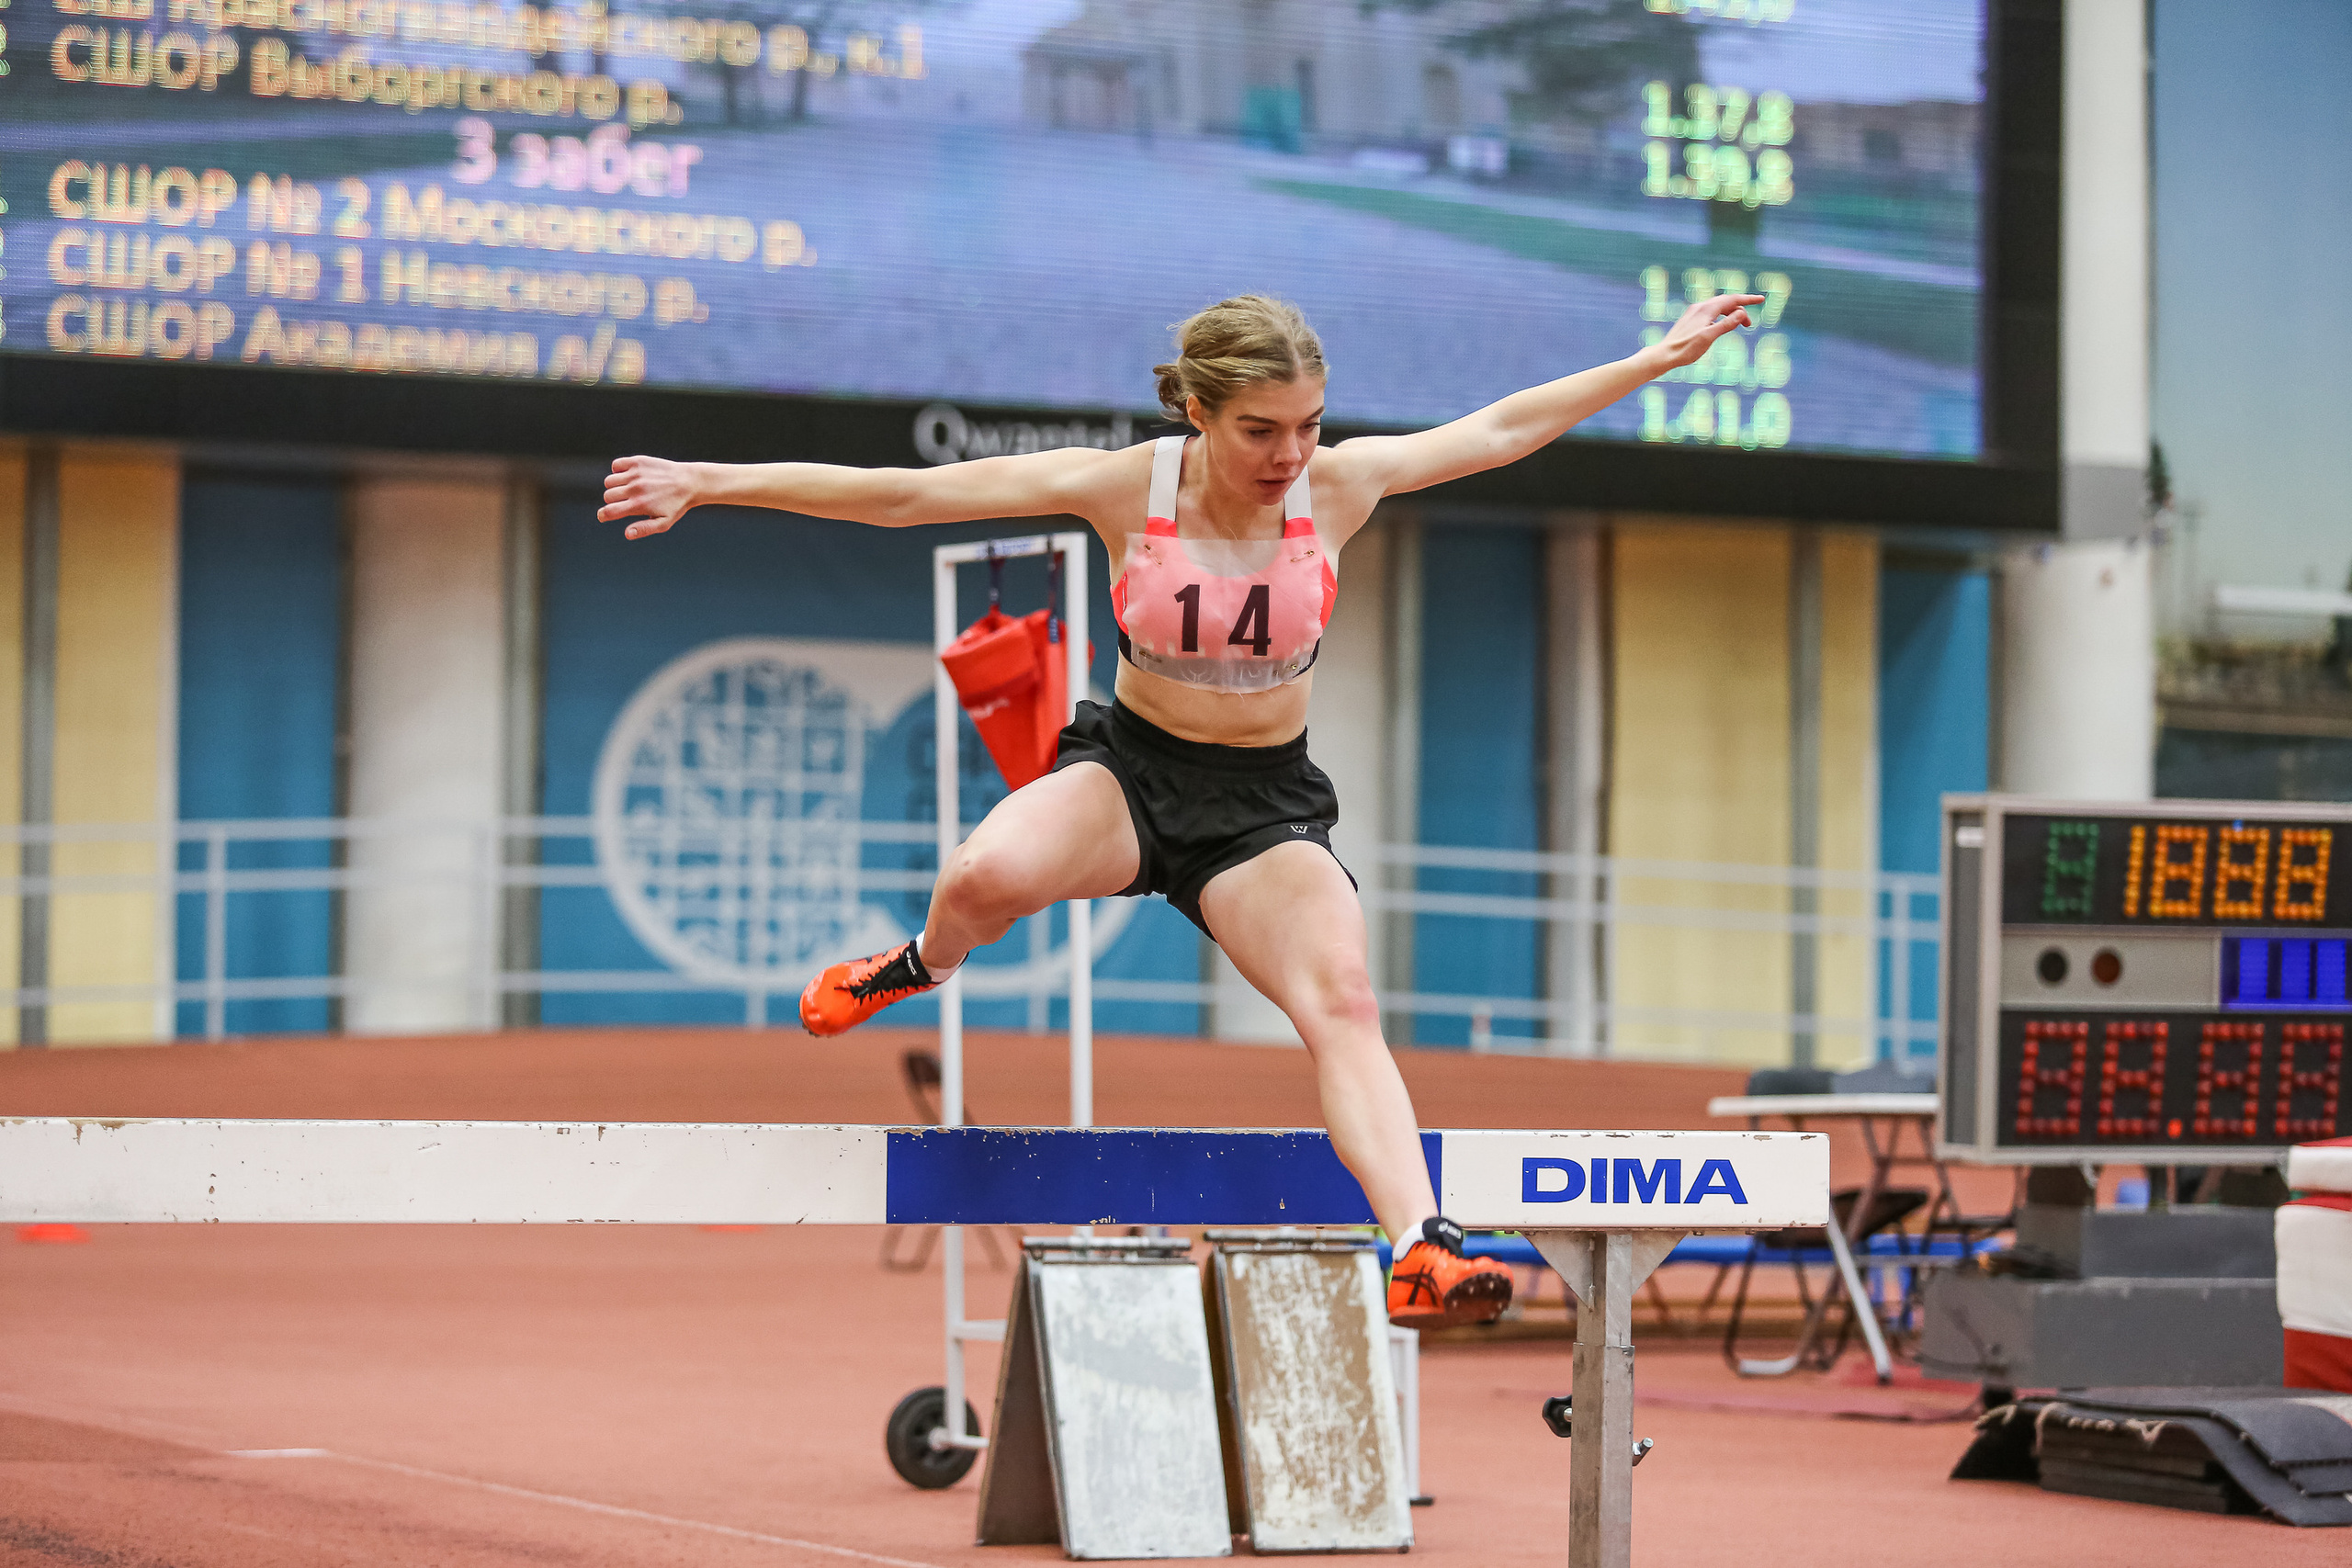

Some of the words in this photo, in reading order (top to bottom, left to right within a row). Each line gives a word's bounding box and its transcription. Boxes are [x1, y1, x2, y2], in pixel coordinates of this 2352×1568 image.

[51, 24, 240, 92] СШОР
[249, 37, 620, 121] Выборгского
[627, 79, 684, 130] р.
[454, 117, 497, 186] 3
[511, 122, 703, 198] забег
[49, 160, 238, 228] СШОР
[246, 172, 322, 236] №
[333, 177, 371, 239] 2
[381, 182, 758, 263] Московского
[762, 220, 819, 273] р.
[47, 227, 236, 293] СШОР
[246, 240, 321, 300] №
[333, 244, 370, 304] 1
[379, 248, 649, 320] Невского
[654, 277, 710, 329] р.
[47, 293, 235, 361] СШОР
[241, 305, 539, 378] Академия
[1174, 584, 1272, 657] 14
[1521, 1157, 1749, 1205] DIMA
